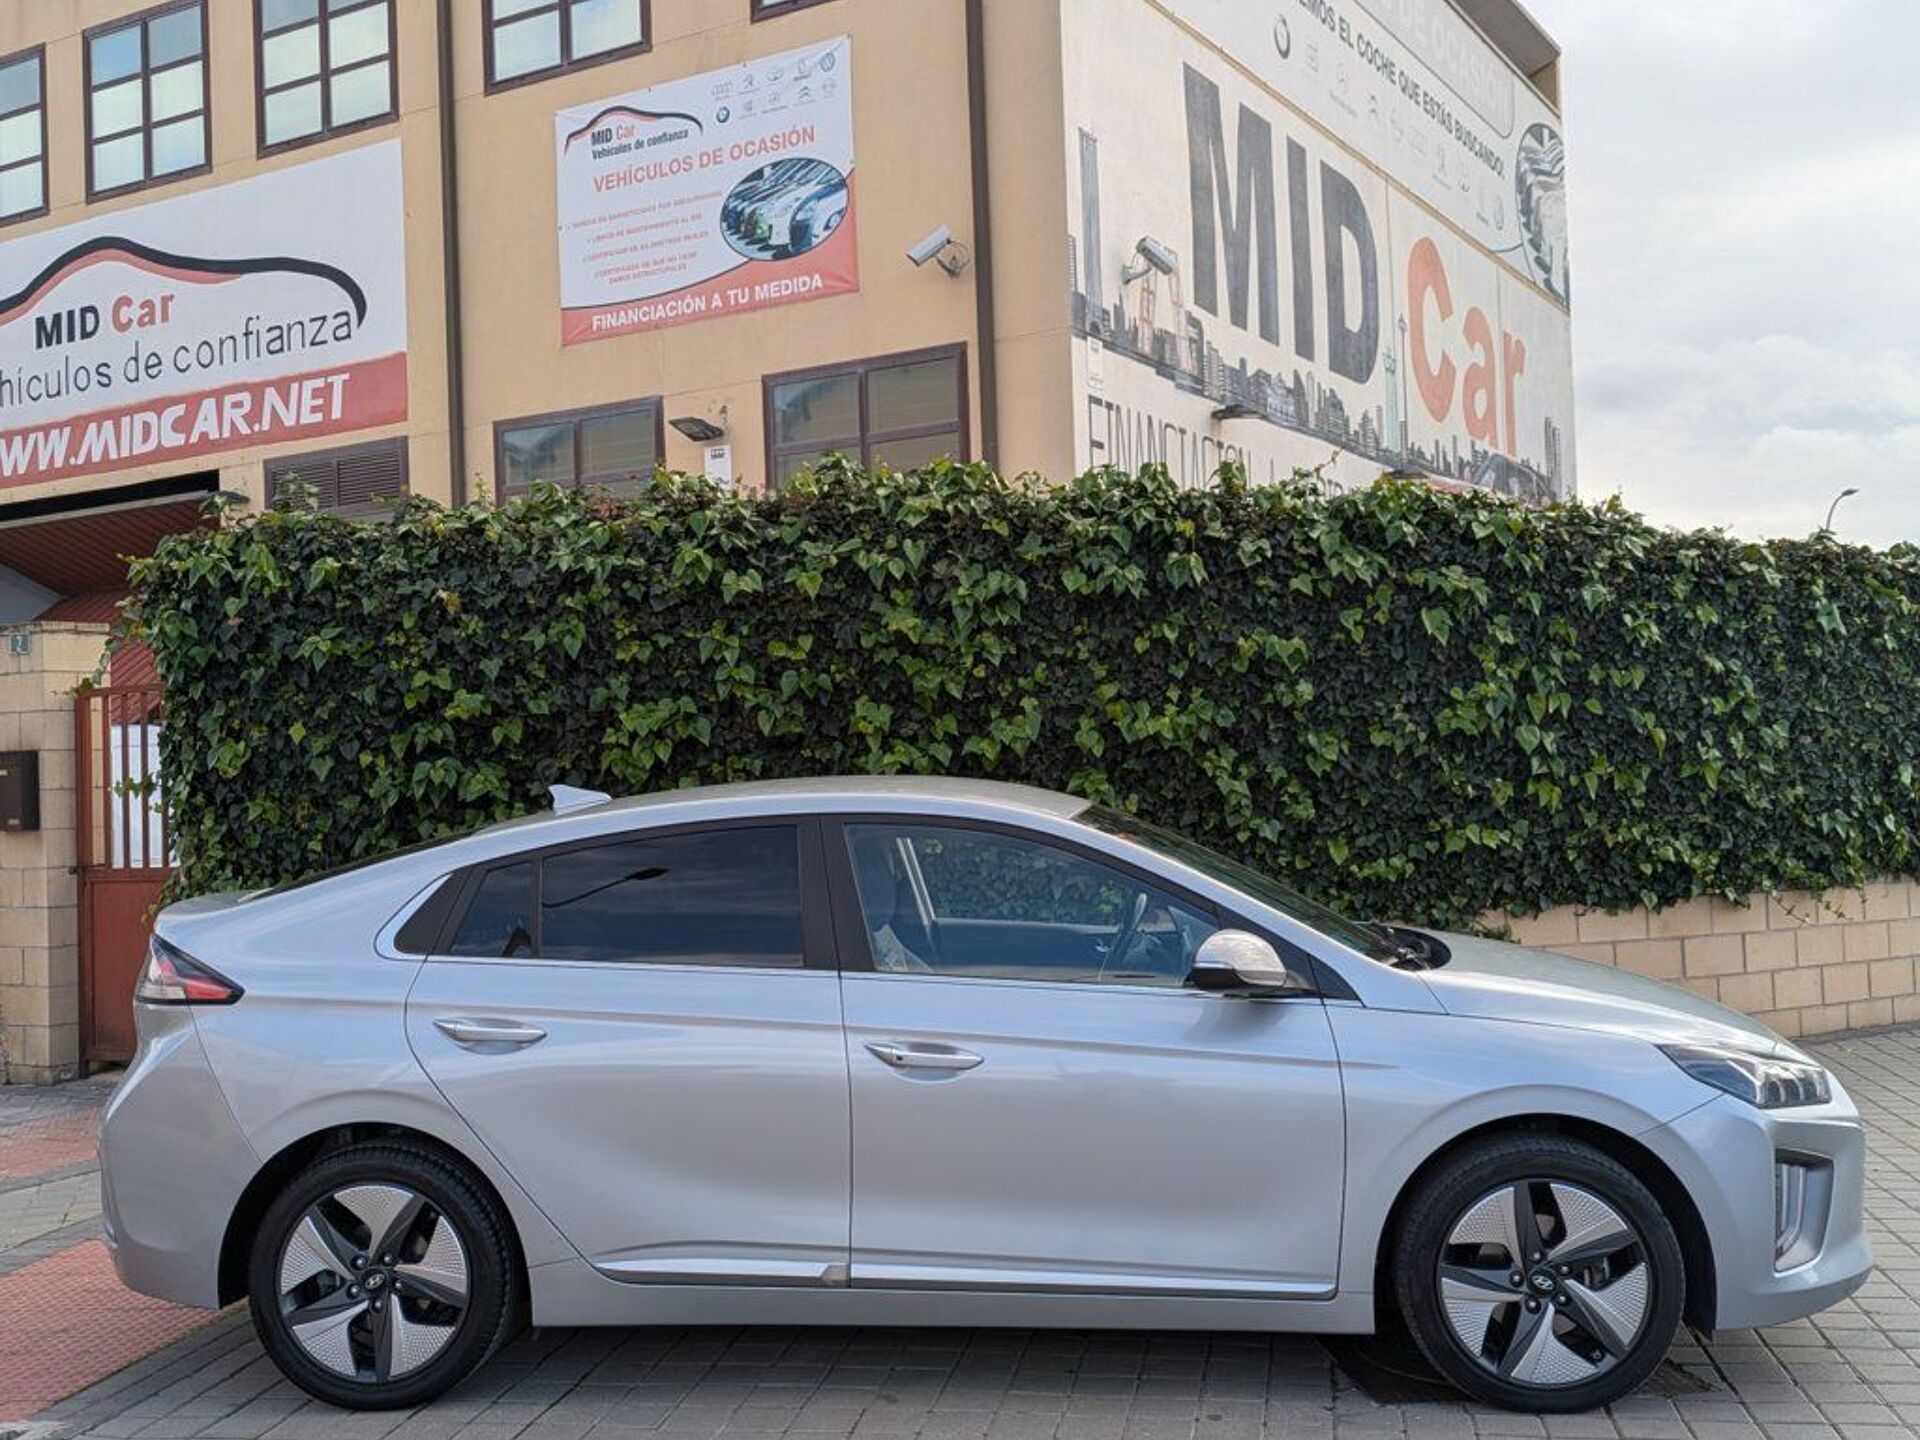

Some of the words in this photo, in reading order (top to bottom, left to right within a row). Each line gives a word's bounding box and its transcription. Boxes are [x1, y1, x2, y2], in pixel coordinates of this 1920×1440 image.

[1300, 0, 1335, 32] MOS
[1339, 15, 1354, 49] EL
[1357, 32, 1396, 85] COCHE
[1399, 69, 1421, 106] QUE
[591, 127, 613, 146] MID
[616, 124, 635, 140] Car
[593, 155, 693, 192] VEHÍCULOS
[699, 147, 724, 169] DE
[729, 125, 815, 161] OCASIÓN
[635, 139, 645, 150] de
[647, 129, 689, 146] confianza
[1183, 60, 1380, 386] MID
[1407, 236, 1526, 458] Car
[35, 304, 100, 350] MID
[111, 293, 175, 333] Car
[592, 295, 706, 331] FINANCIACIÓN
[709, 293, 722, 309] A
[726, 286, 749, 305] TU
[754, 273, 823, 299] MEDIDA
[123, 340, 163, 384] de
[173, 310, 353, 373] confianza
